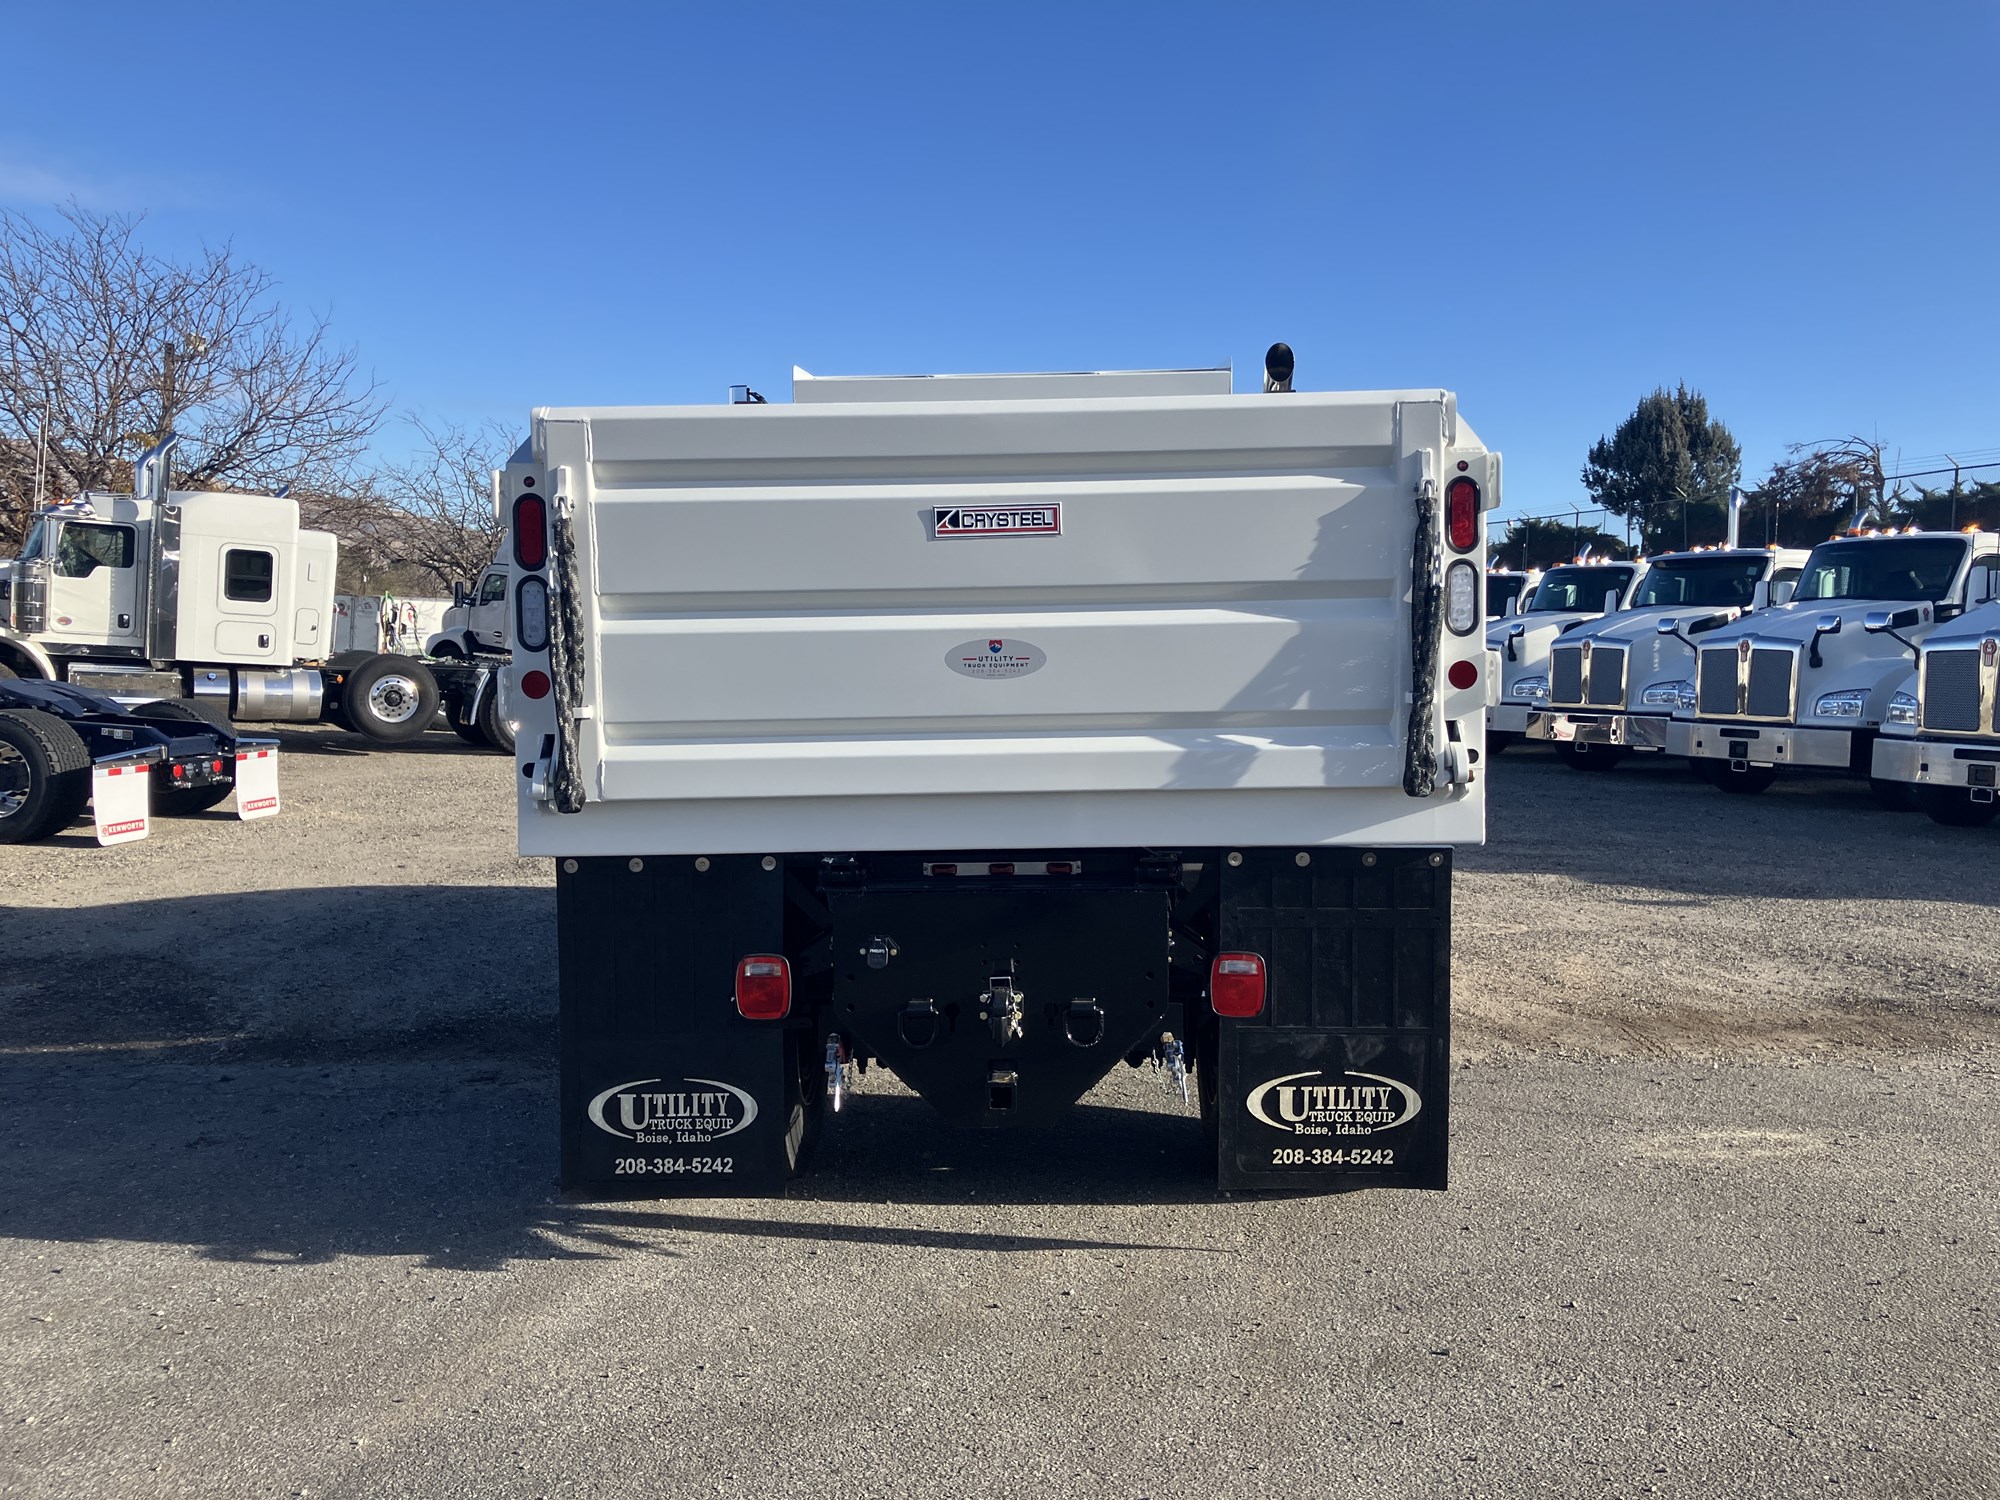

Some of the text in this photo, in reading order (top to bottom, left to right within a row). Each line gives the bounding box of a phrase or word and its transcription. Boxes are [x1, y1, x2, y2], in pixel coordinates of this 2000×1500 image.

[962, 511, 1053, 528] CRYSTEEL
[247, 798, 277, 810] KENWORTH
[108, 820, 144, 834] KENWORTH
[1276, 1086, 1392, 1122] UTILITY
[617, 1093, 730, 1130] UTILITY
[1308, 1111, 1396, 1124] TRUCK EQUIP
[649, 1118, 734, 1131] TRUCK EQUIP
[1294, 1123, 1372, 1136] Boise, Idaho
[635, 1132, 712, 1144] Boise, Idaho
[1272, 1148, 1394, 1165] 208-384-5242
[614, 1157, 733, 1175] 208-384-5242
